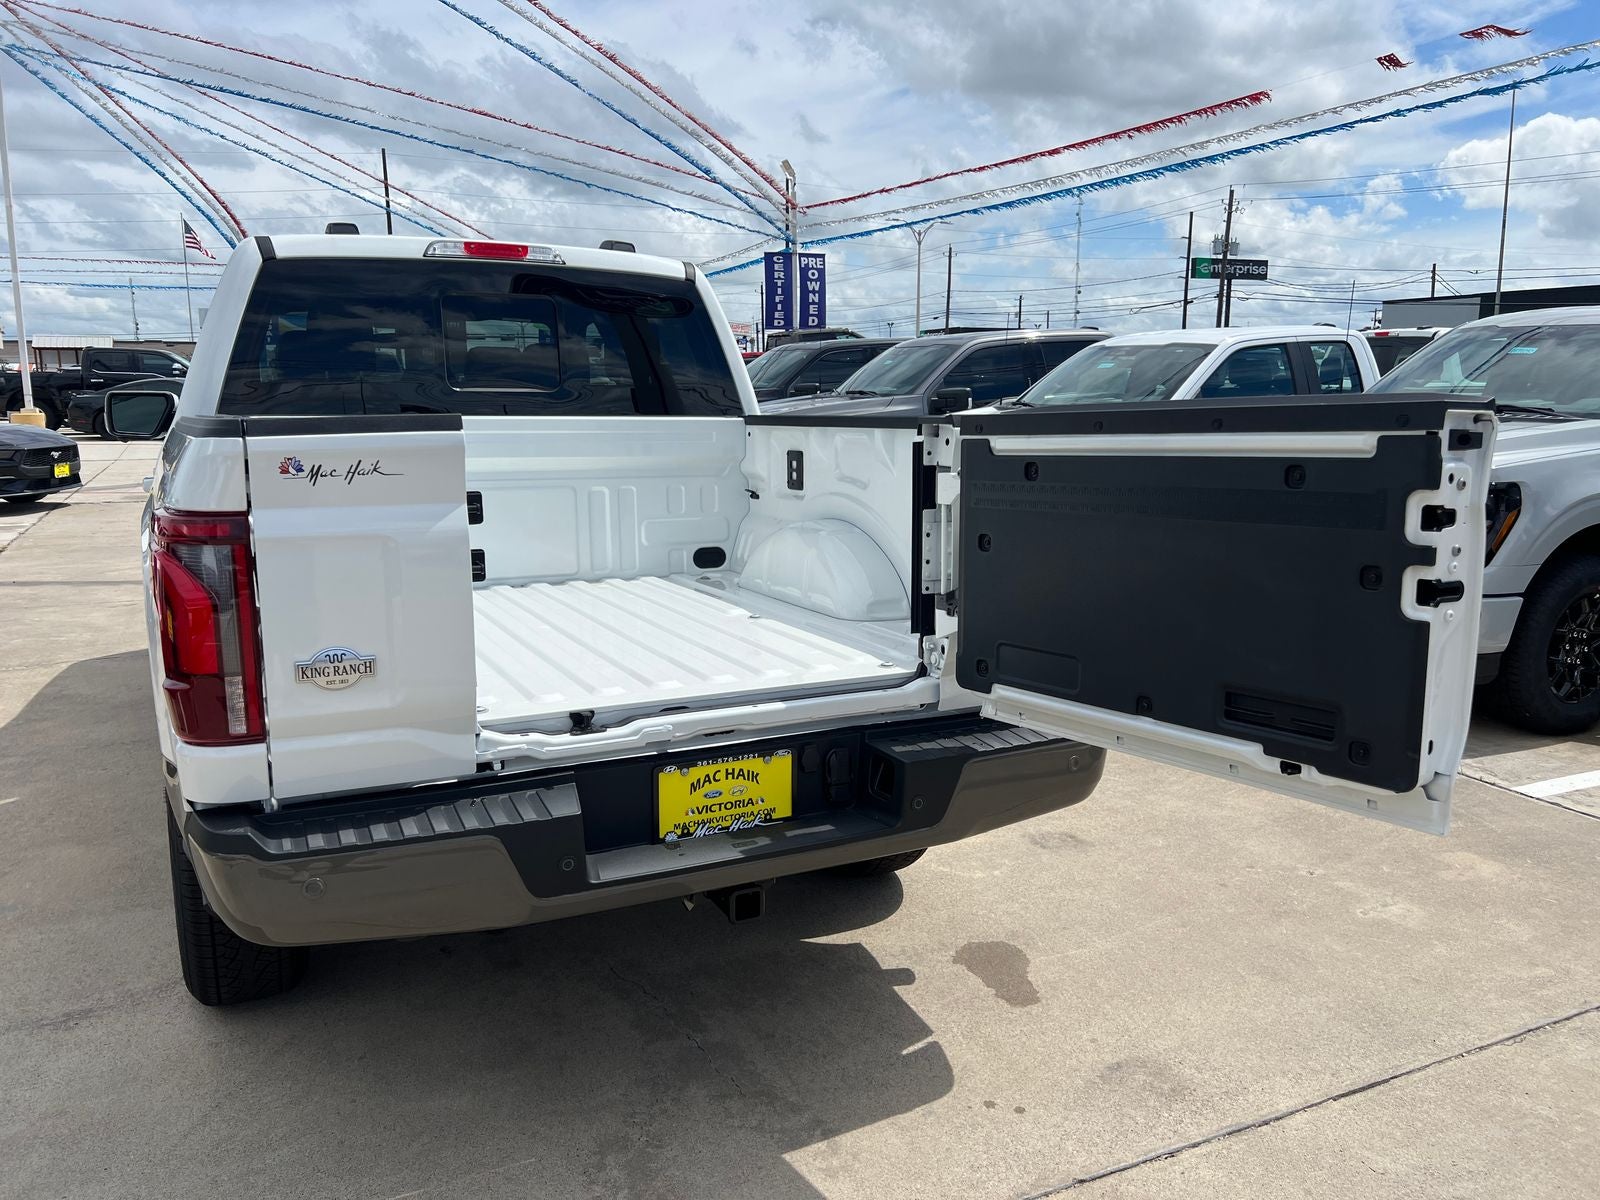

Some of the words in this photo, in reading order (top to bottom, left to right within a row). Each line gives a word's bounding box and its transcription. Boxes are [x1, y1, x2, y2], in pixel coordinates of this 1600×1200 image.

[800, 257, 824, 269] PRE
[773, 256, 785, 326] CERTIFIED
[807, 269, 820, 326] OWNED
[301, 463, 342, 486] Mac
[344, 459, 402, 485] Haik
[301, 666, 330, 679] KING
[333, 661, 373, 676] RANCH
[690, 770, 721, 795] MAC
[725, 768, 760, 784] HAIK
[696, 798, 755, 814] VICTORIA
[691, 822, 728, 838] Mac
[729, 813, 774, 832] Haik
